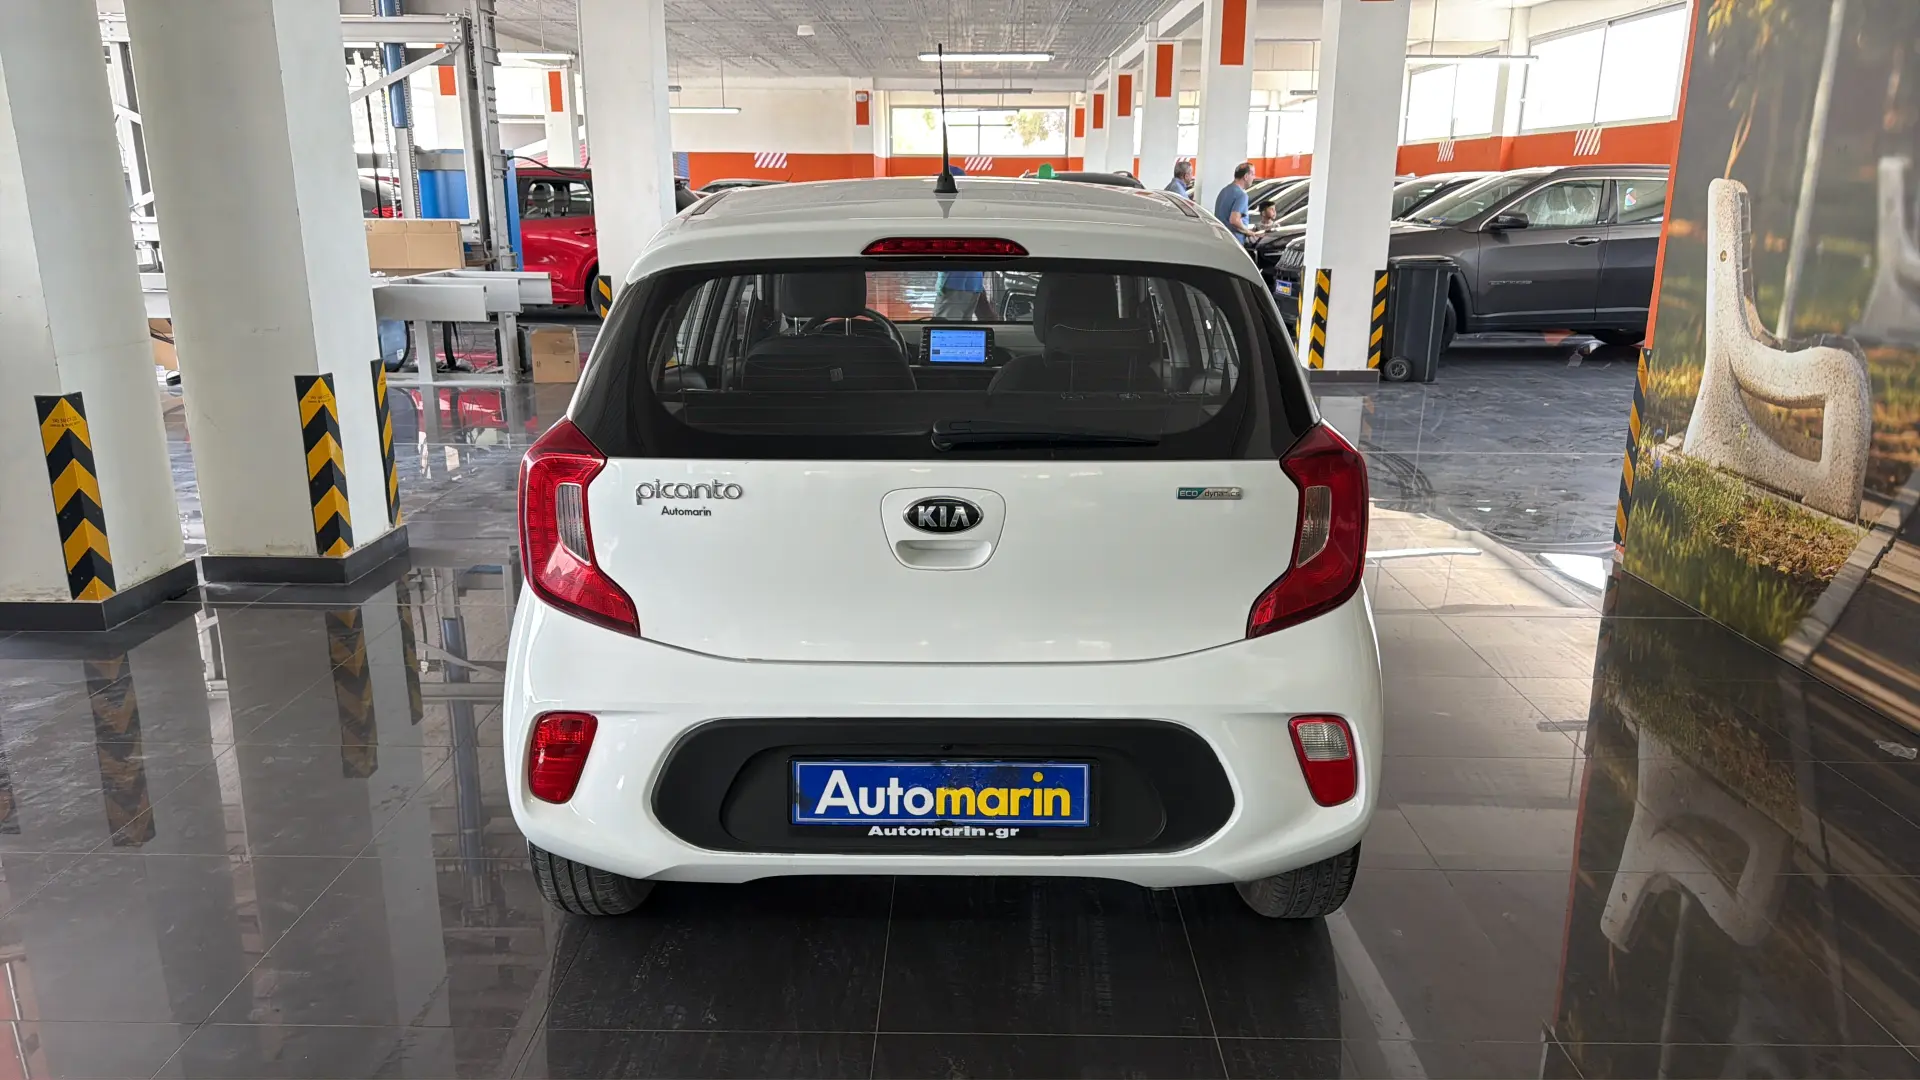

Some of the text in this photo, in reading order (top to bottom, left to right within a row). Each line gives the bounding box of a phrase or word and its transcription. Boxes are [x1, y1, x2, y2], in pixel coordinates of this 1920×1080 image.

[635, 479, 743, 505] picanto
[1179, 489, 1241, 498] ECO dynacs
[661, 505, 712, 516] Automarin
[917, 505, 970, 527] KIA
[814, 769, 1071, 817] Automarin
[867, 826, 1020, 839] Automarin.gr
